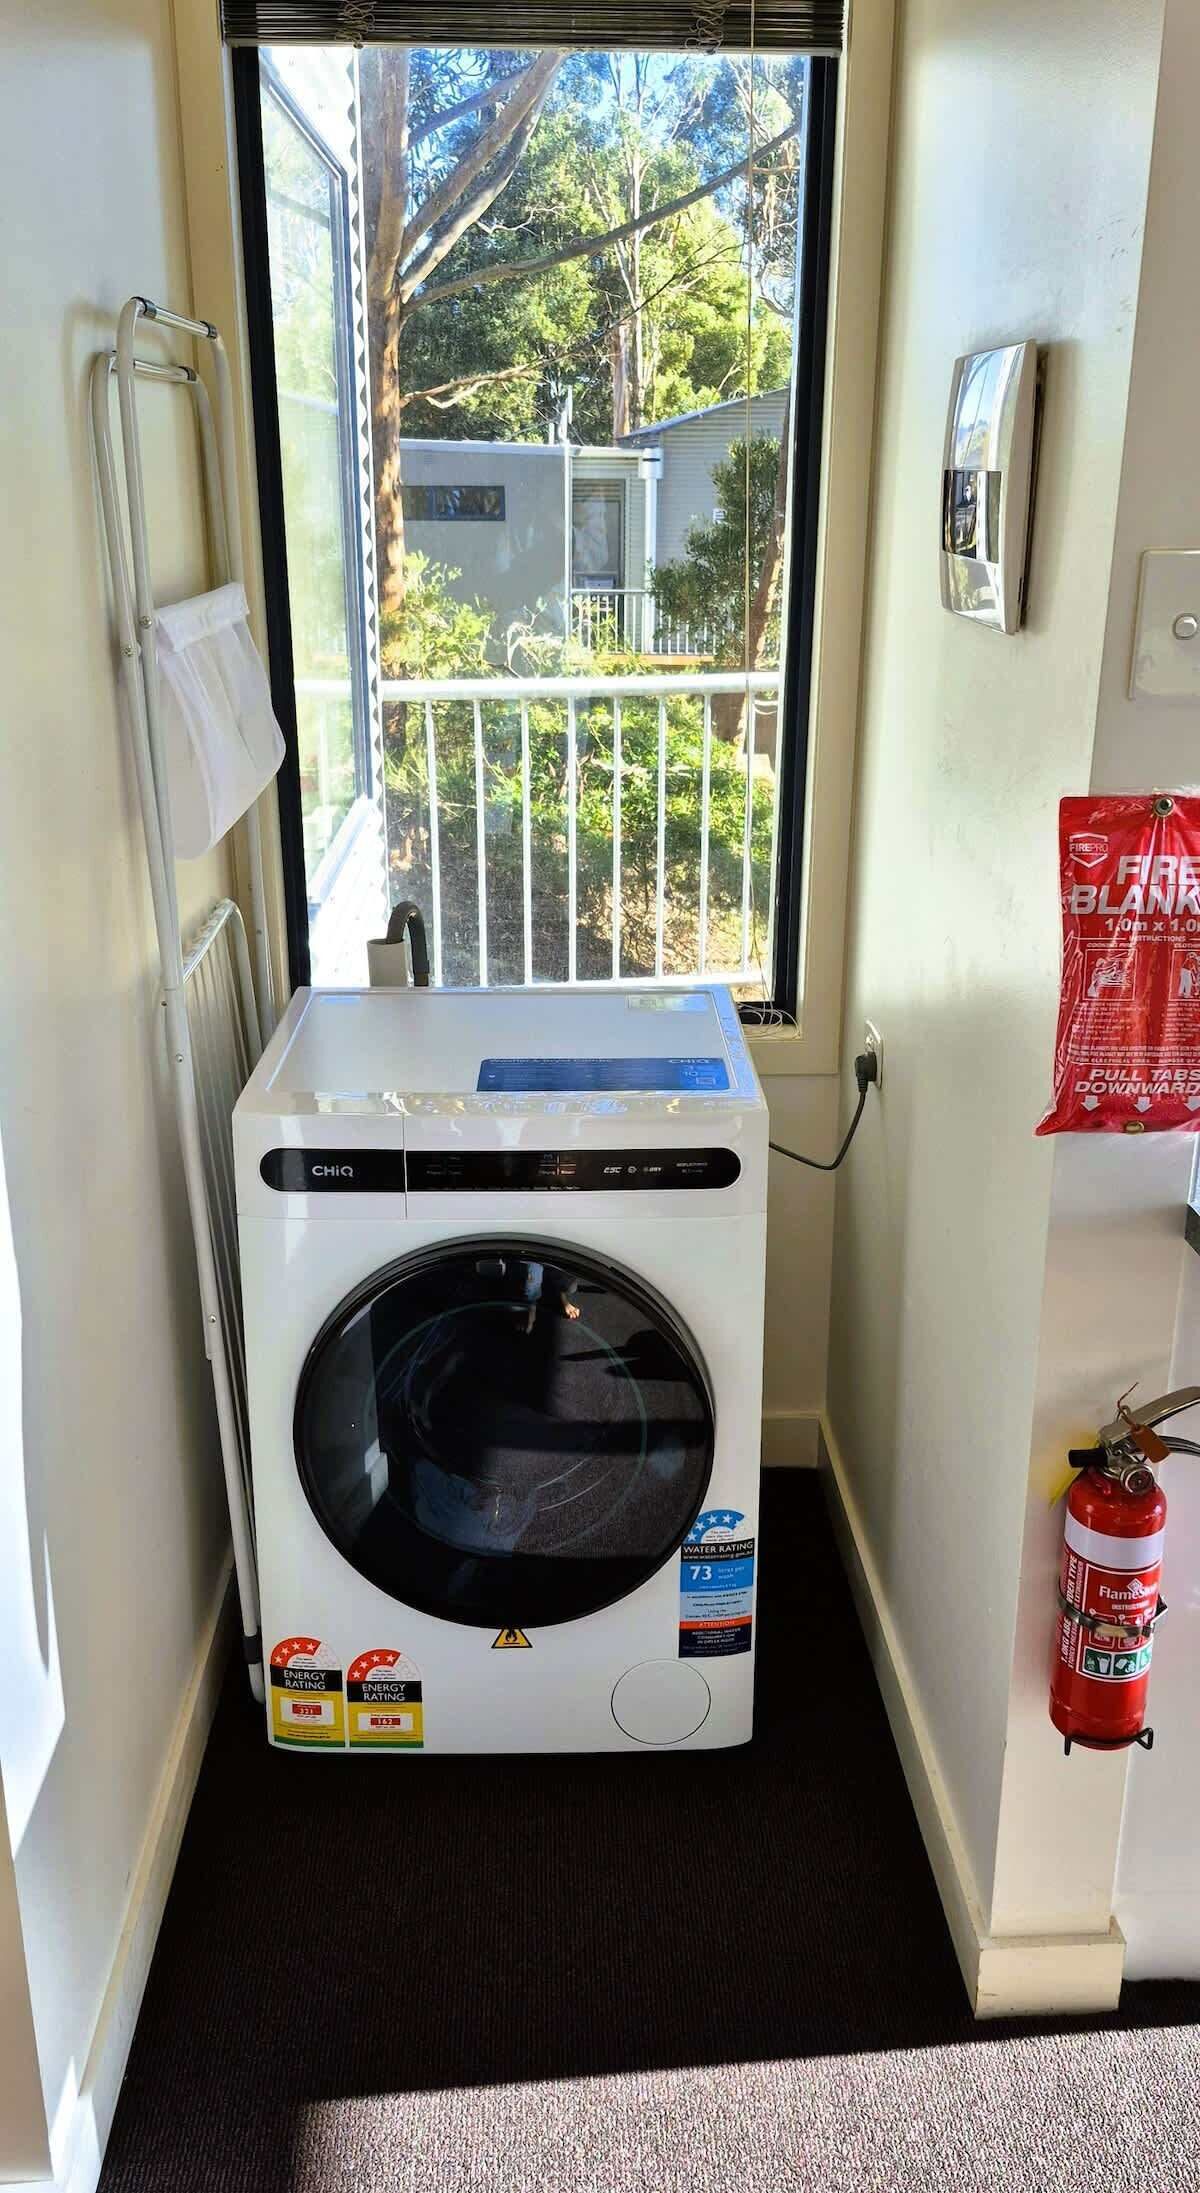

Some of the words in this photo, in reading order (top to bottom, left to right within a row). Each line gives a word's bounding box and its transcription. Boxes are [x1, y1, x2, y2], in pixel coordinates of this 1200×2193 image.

[1069, 843, 1108, 852] FIREPRO
[1116, 855, 1200, 885] FIRE
[1153, 923, 1165, 932] x
[1089, 1069, 1143, 1081] PULL
[1151, 1069, 1200, 1081] TABS
[312, 1165, 354, 1178] CHiQ
[683, 1545, 717, 1554] WATER
[719, 1541, 753, 1553] RATING
[689, 1565, 712, 1581] 73
[284, 1670, 327, 1681] ENERGY
[285, 1680, 326, 1690] RATING
[362, 1683, 406, 1692] ENERGY
[363, 1693, 406, 1702] RATING
